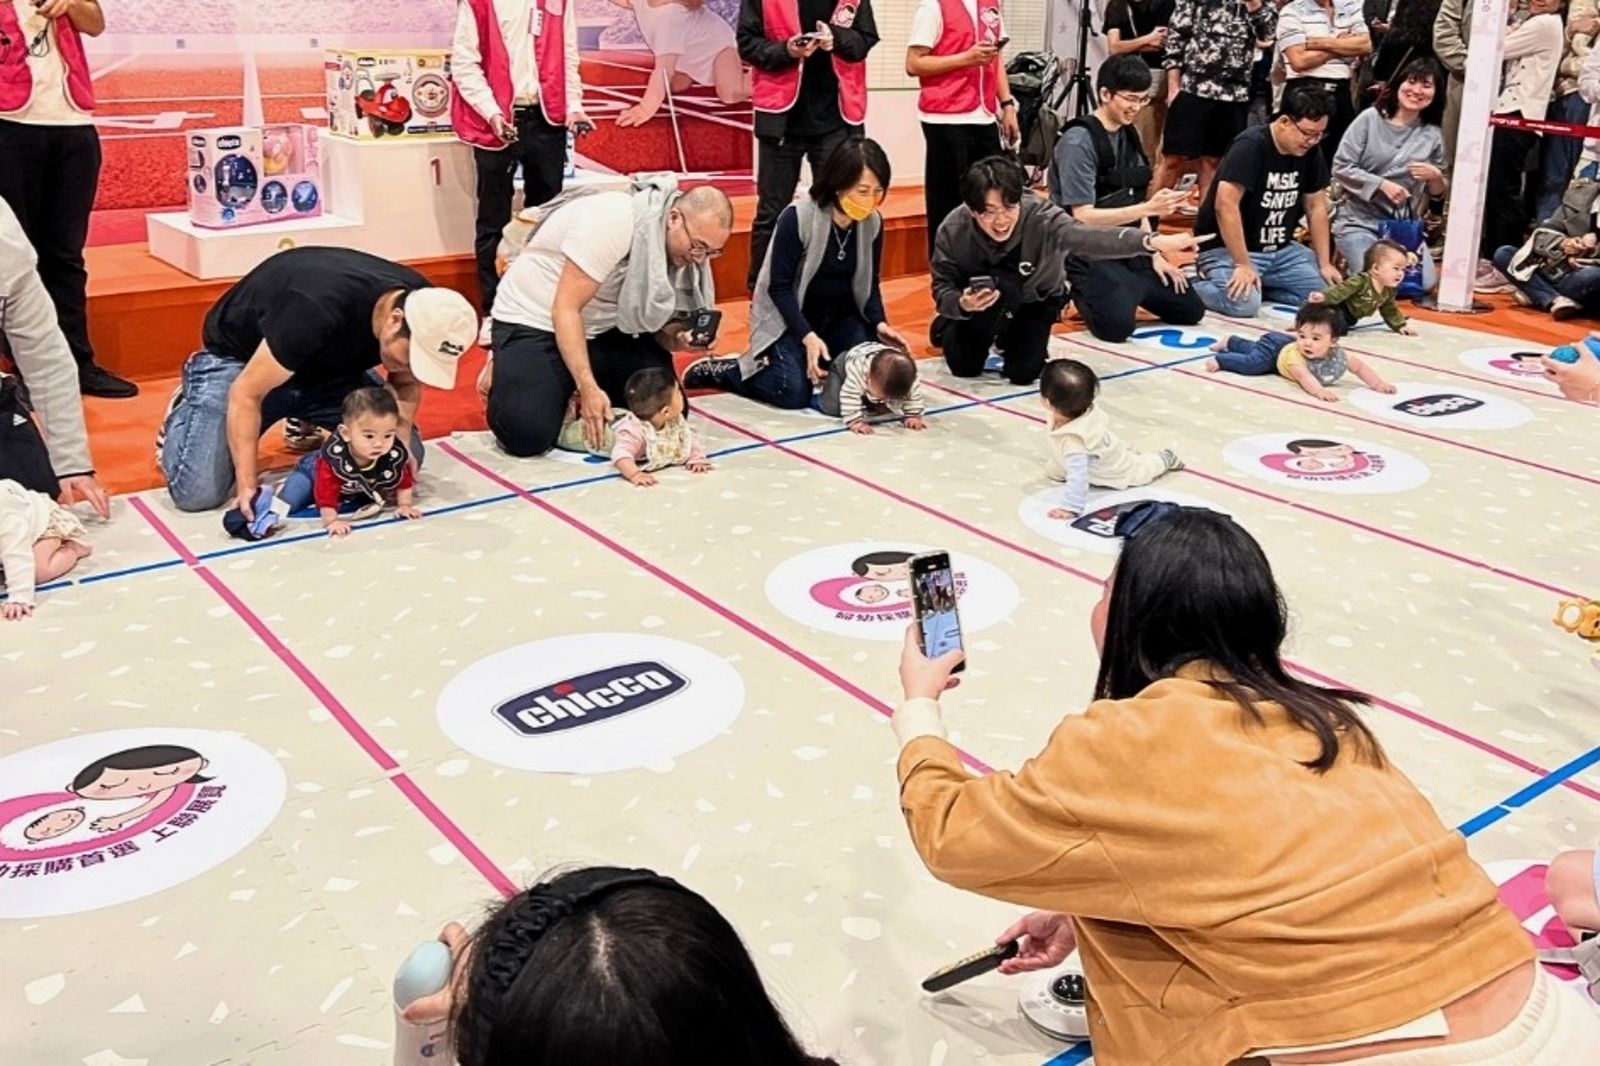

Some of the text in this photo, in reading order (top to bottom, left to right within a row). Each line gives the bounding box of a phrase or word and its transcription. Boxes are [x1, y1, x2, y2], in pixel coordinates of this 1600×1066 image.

[430, 158, 442, 185] 1
[1260, 226, 1287, 244] LIFE
[516, 669, 673, 729] chicco
